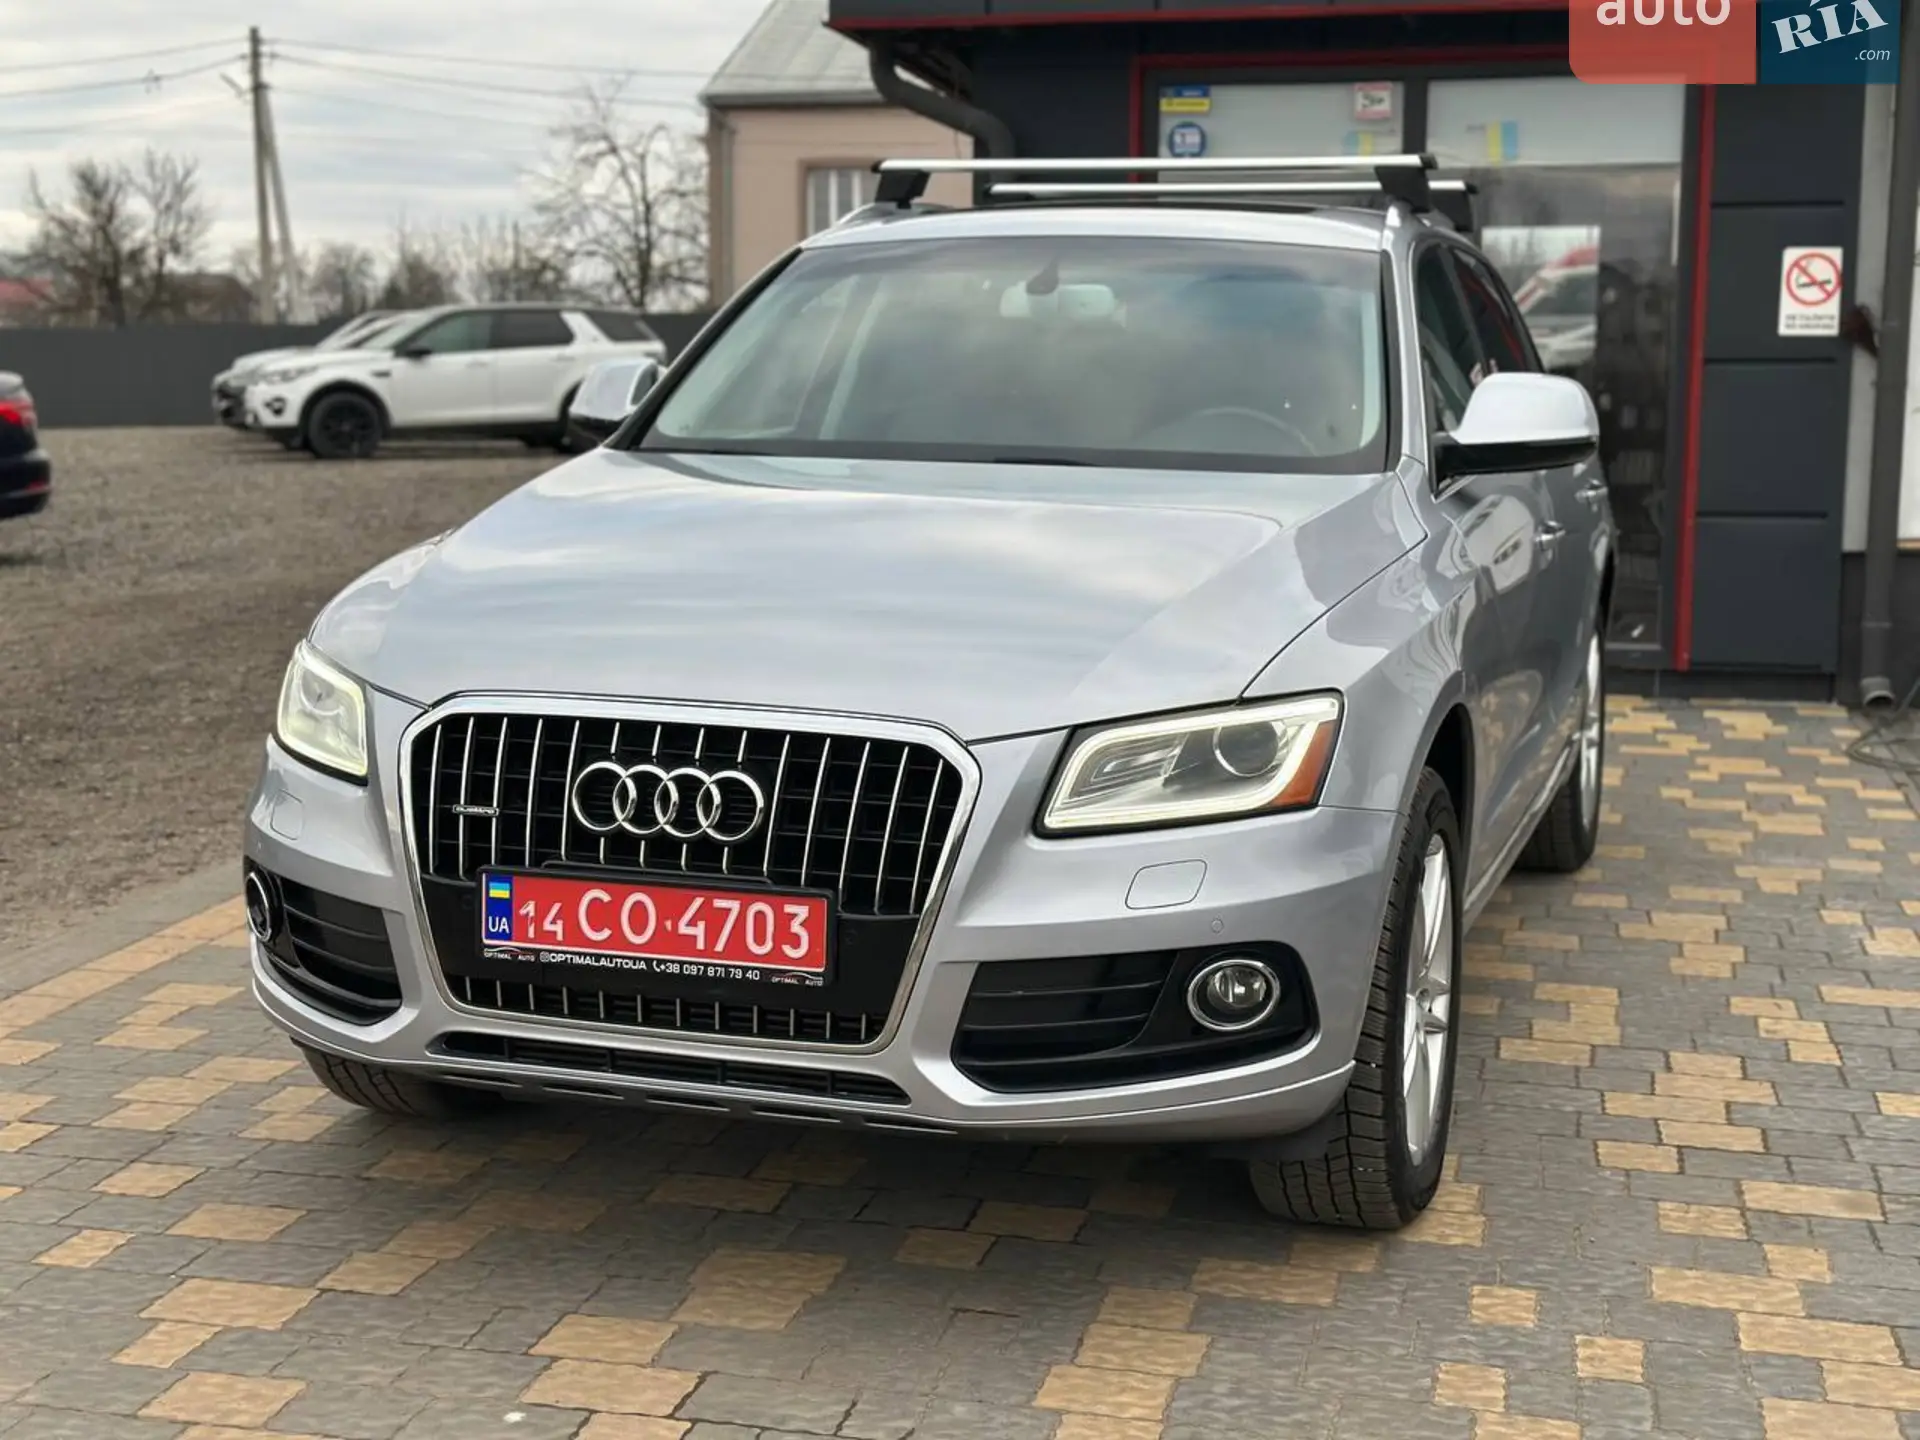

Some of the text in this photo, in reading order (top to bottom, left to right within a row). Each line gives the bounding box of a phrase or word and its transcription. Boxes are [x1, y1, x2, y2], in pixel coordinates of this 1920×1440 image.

[488, 916, 510, 934] UA
[519, 900, 564, 941] 14
[677, 896, 810, 960] 4703
[483, 951, 512, 960] OPTIMAL
[683, 964, 704, 976] 097
[707, 966, 726, 978] 871
[745, 970, 760, 981] 40
